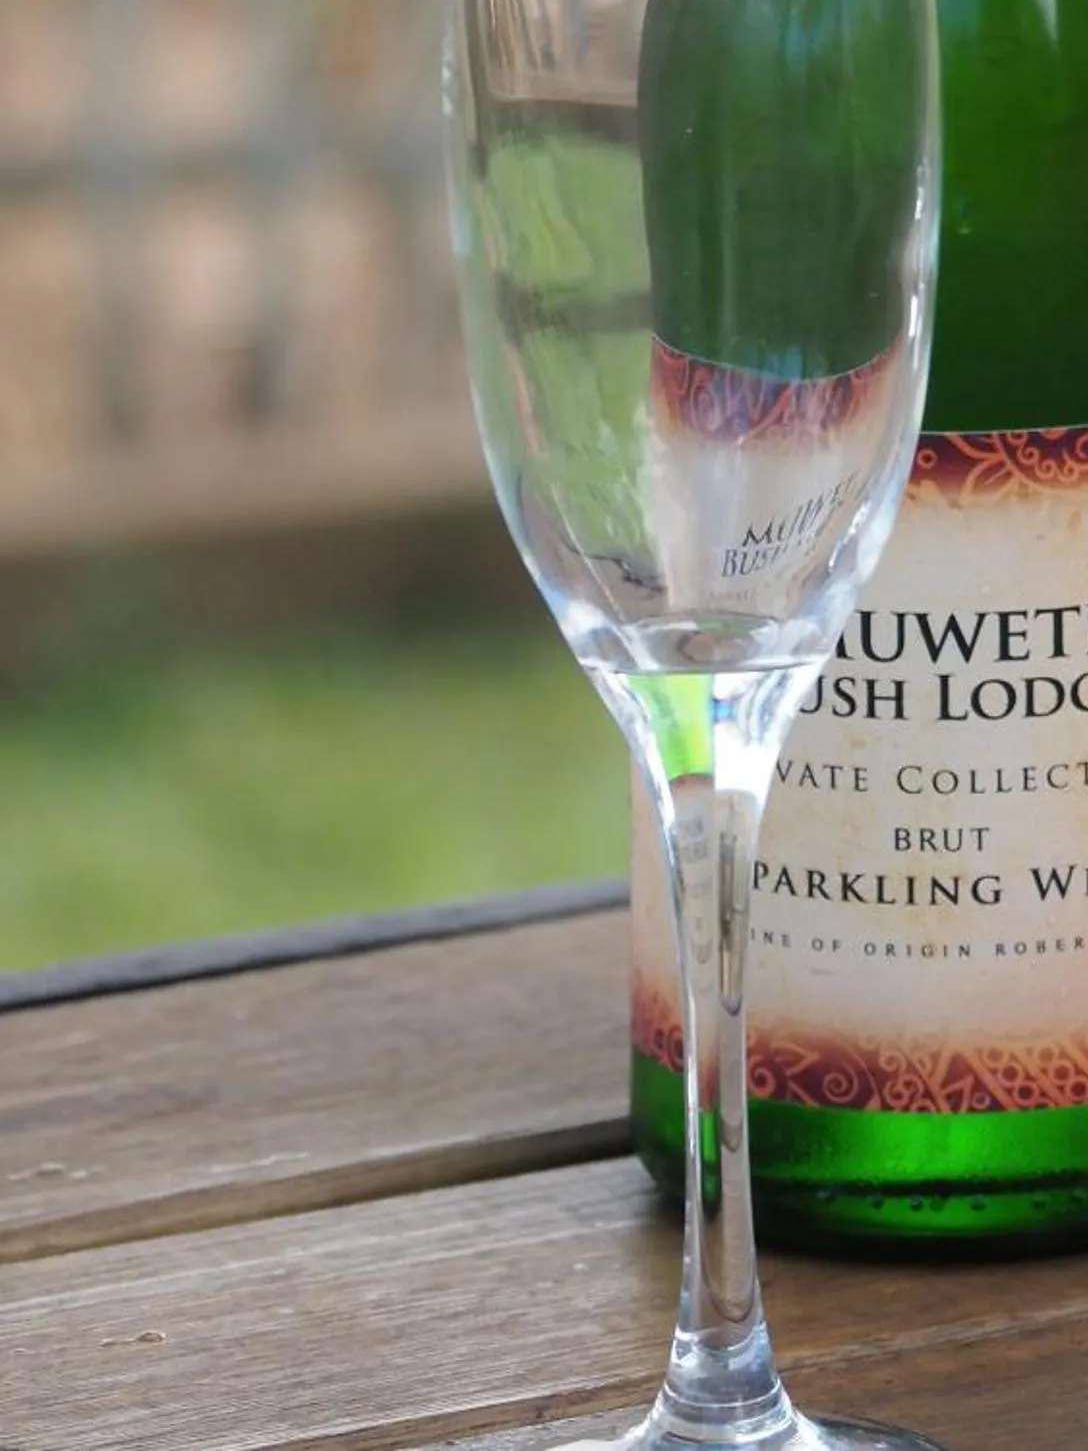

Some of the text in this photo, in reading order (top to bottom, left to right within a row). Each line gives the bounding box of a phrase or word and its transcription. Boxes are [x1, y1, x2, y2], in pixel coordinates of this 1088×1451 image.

[799, 674, 907, 720] USH
[775, 759, 869, 792] VATE
[893, 826, 990, 852] BRUT
[752, 860, 1003, 907] PARKLING
[750, 928, 792, 948] INE
[811, 937, 842, 952] OF
[864, 941, 970, 958] ORIGIN
